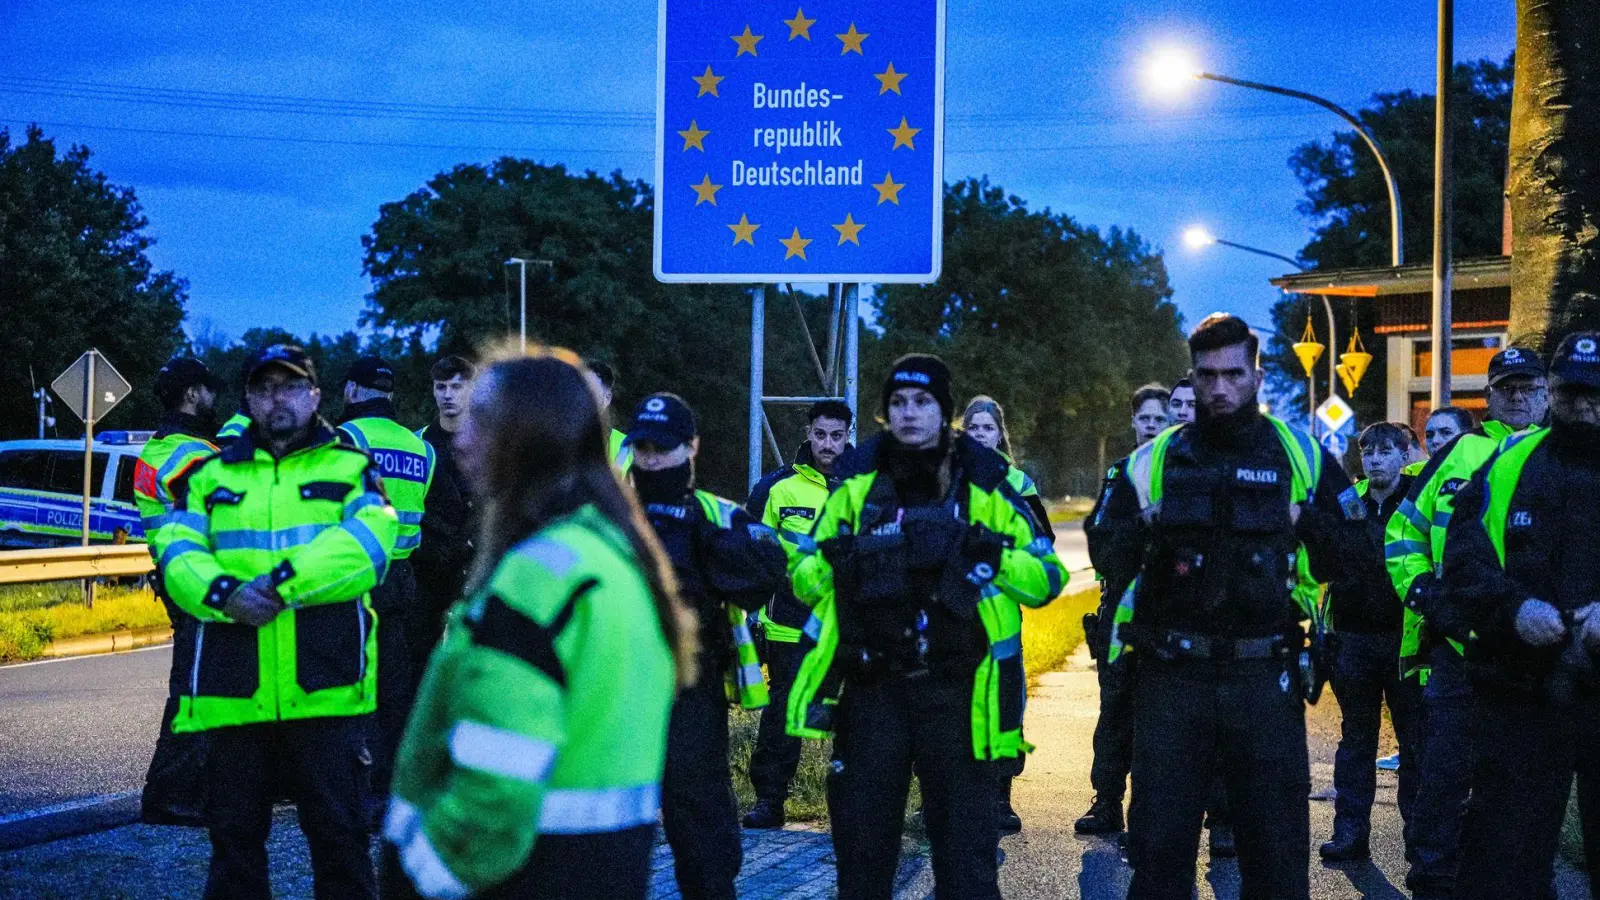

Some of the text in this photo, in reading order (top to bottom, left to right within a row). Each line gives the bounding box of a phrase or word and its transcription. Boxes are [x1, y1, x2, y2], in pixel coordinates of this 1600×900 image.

[753, 82, 844, 108] Bundes-
[753, 121, 842, 153] republik
[732, 159, 863, 187] Deutschland
[374, 452, 424, 478] POLIZEI
[1236, 468, 1277, 482] POLIZEI
[47, 510, 83, 527] POLIZE
